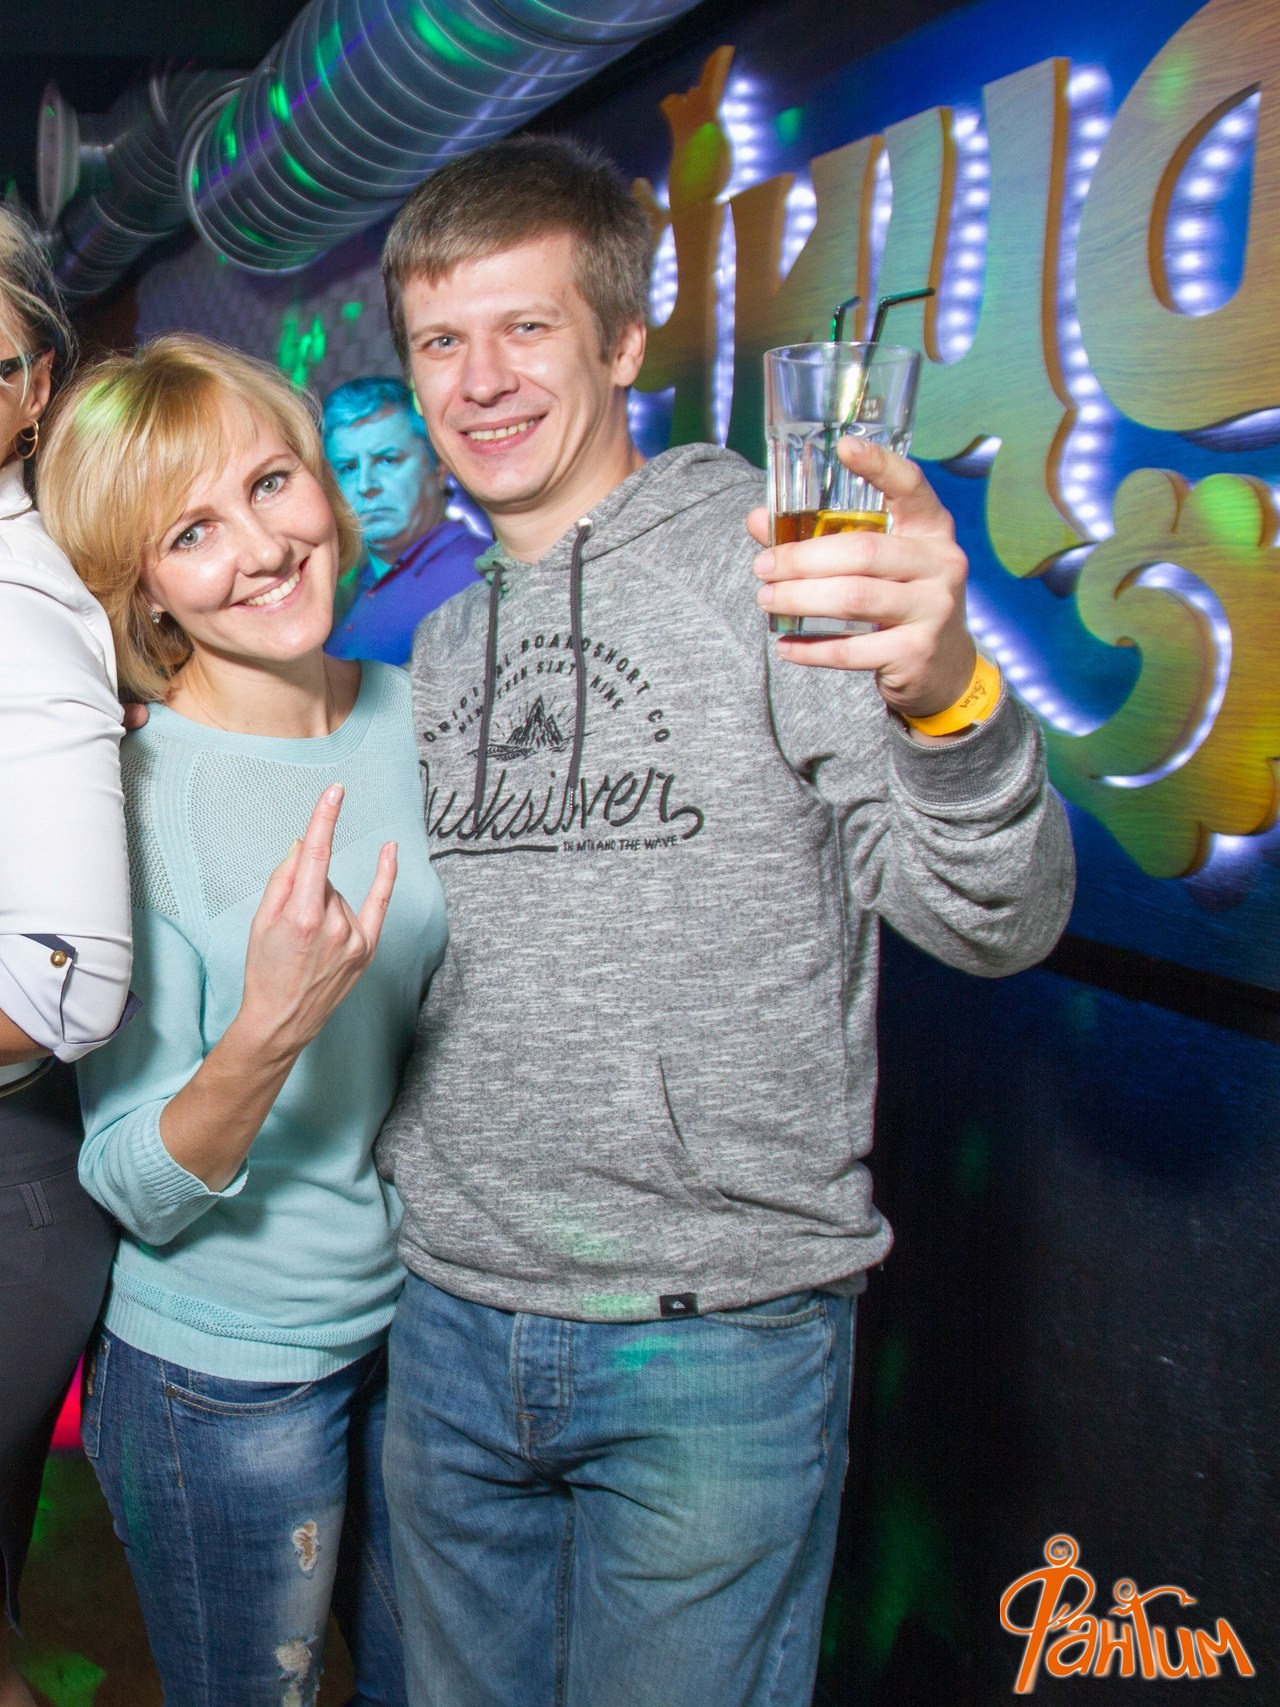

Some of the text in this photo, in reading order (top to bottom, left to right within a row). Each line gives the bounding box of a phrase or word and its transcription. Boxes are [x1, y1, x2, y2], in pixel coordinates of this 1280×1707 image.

[423, 653, 512, 743] ORIGIAL
[647, 708, 671, 743] CO
[458, 660, 625, 734] NINTEEN SIXT NINE
[619, 838, 640, 851] THE
[644, 836, 679, 850] WAVE
